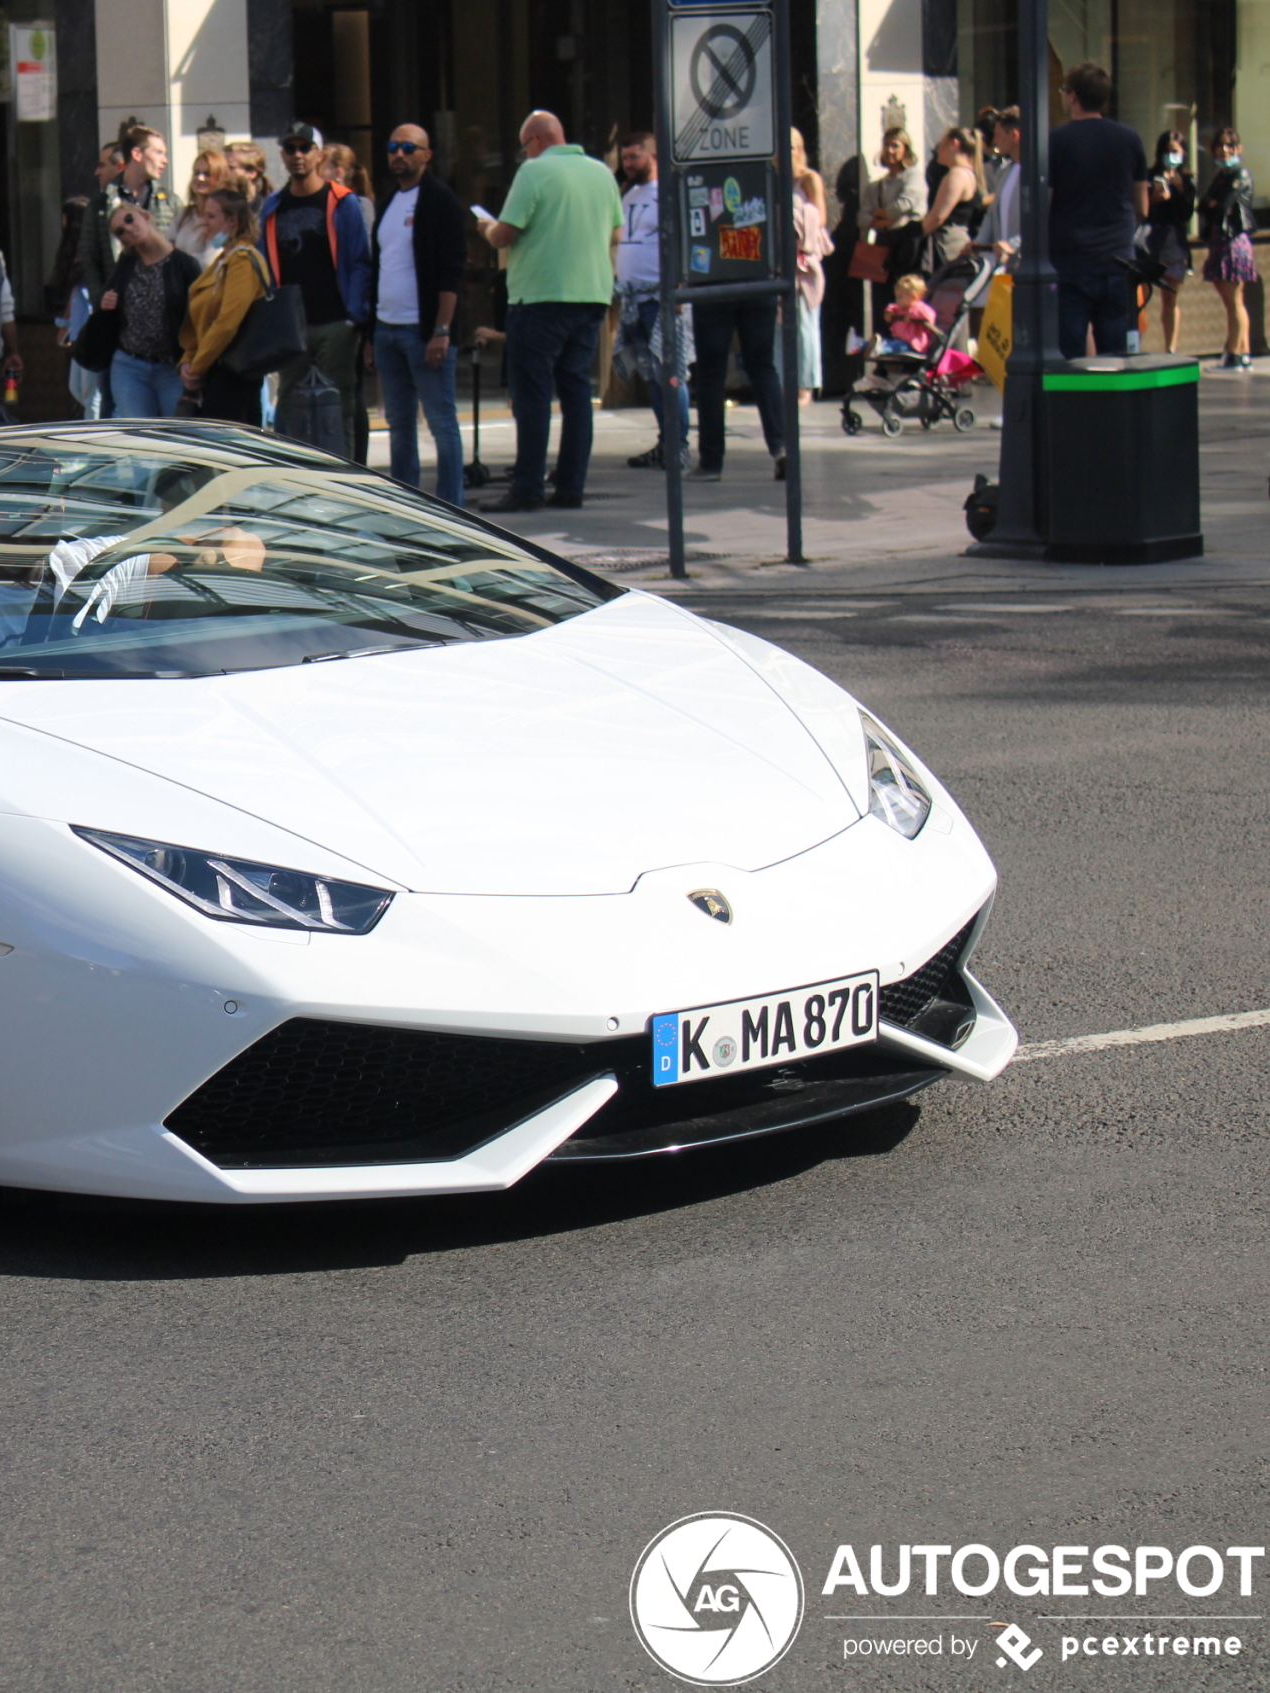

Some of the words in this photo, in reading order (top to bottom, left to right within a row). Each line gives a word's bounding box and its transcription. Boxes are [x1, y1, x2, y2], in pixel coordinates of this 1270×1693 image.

[698, 126, 750, 151] ZONE
[660, 1055, 671, 1072] D
[681, 1016, 711, 1074] K
[741, 1001, 797, 1063] MA
[803, 983, 874, 1049] 870
